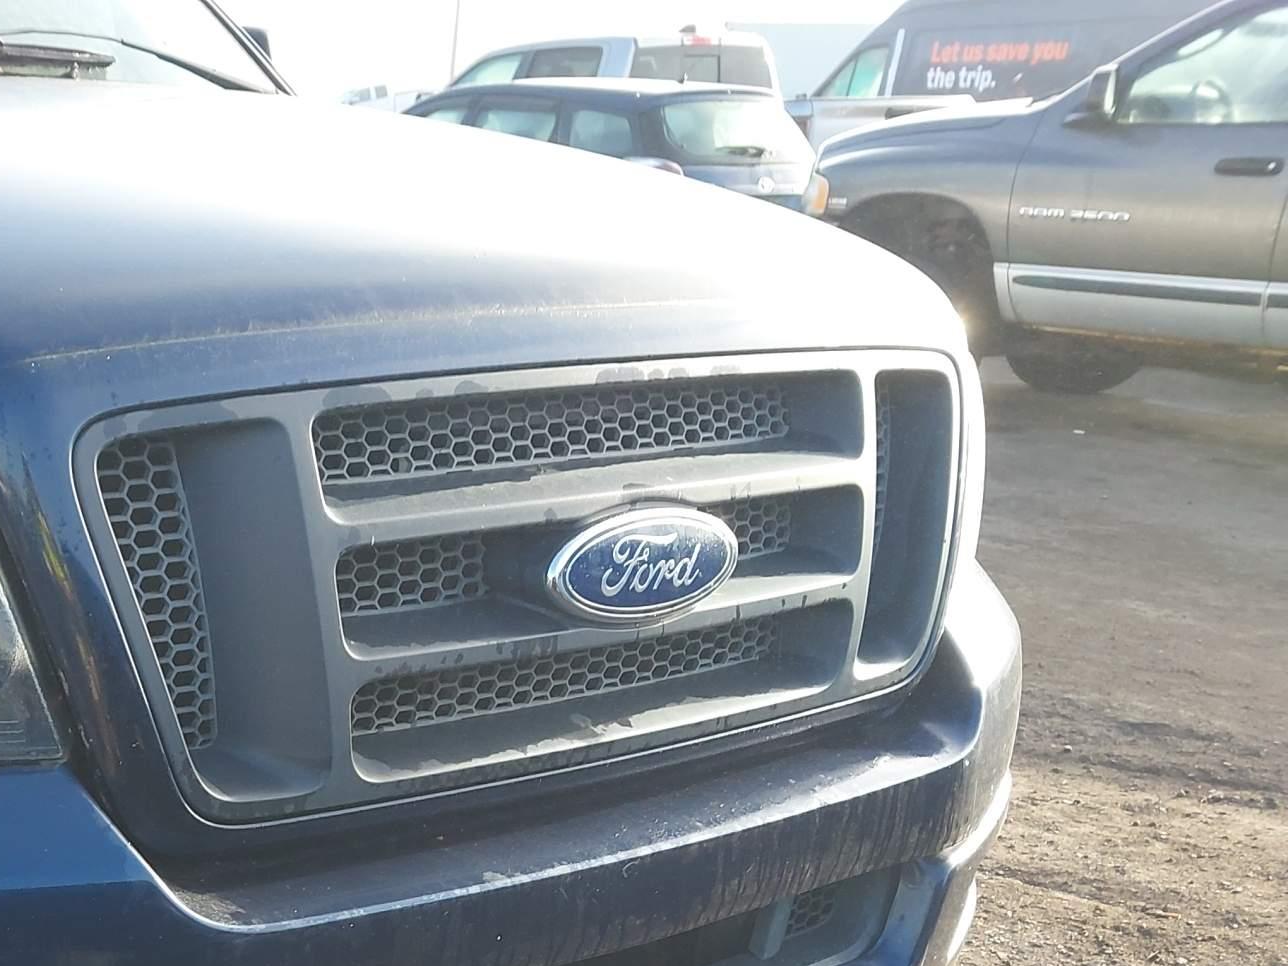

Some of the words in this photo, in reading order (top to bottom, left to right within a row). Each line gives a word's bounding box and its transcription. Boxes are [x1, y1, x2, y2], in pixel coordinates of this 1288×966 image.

[930, 42, 960, 63] Let
[962, 43, 984, 63] us
[987, 42, 1030, 62] save
[1031, 42, 1069, 65] you
[926, 66, 955, 89] the
[959, 65, 996, 91] trip.
[600, 531, 701, 598] Ford
